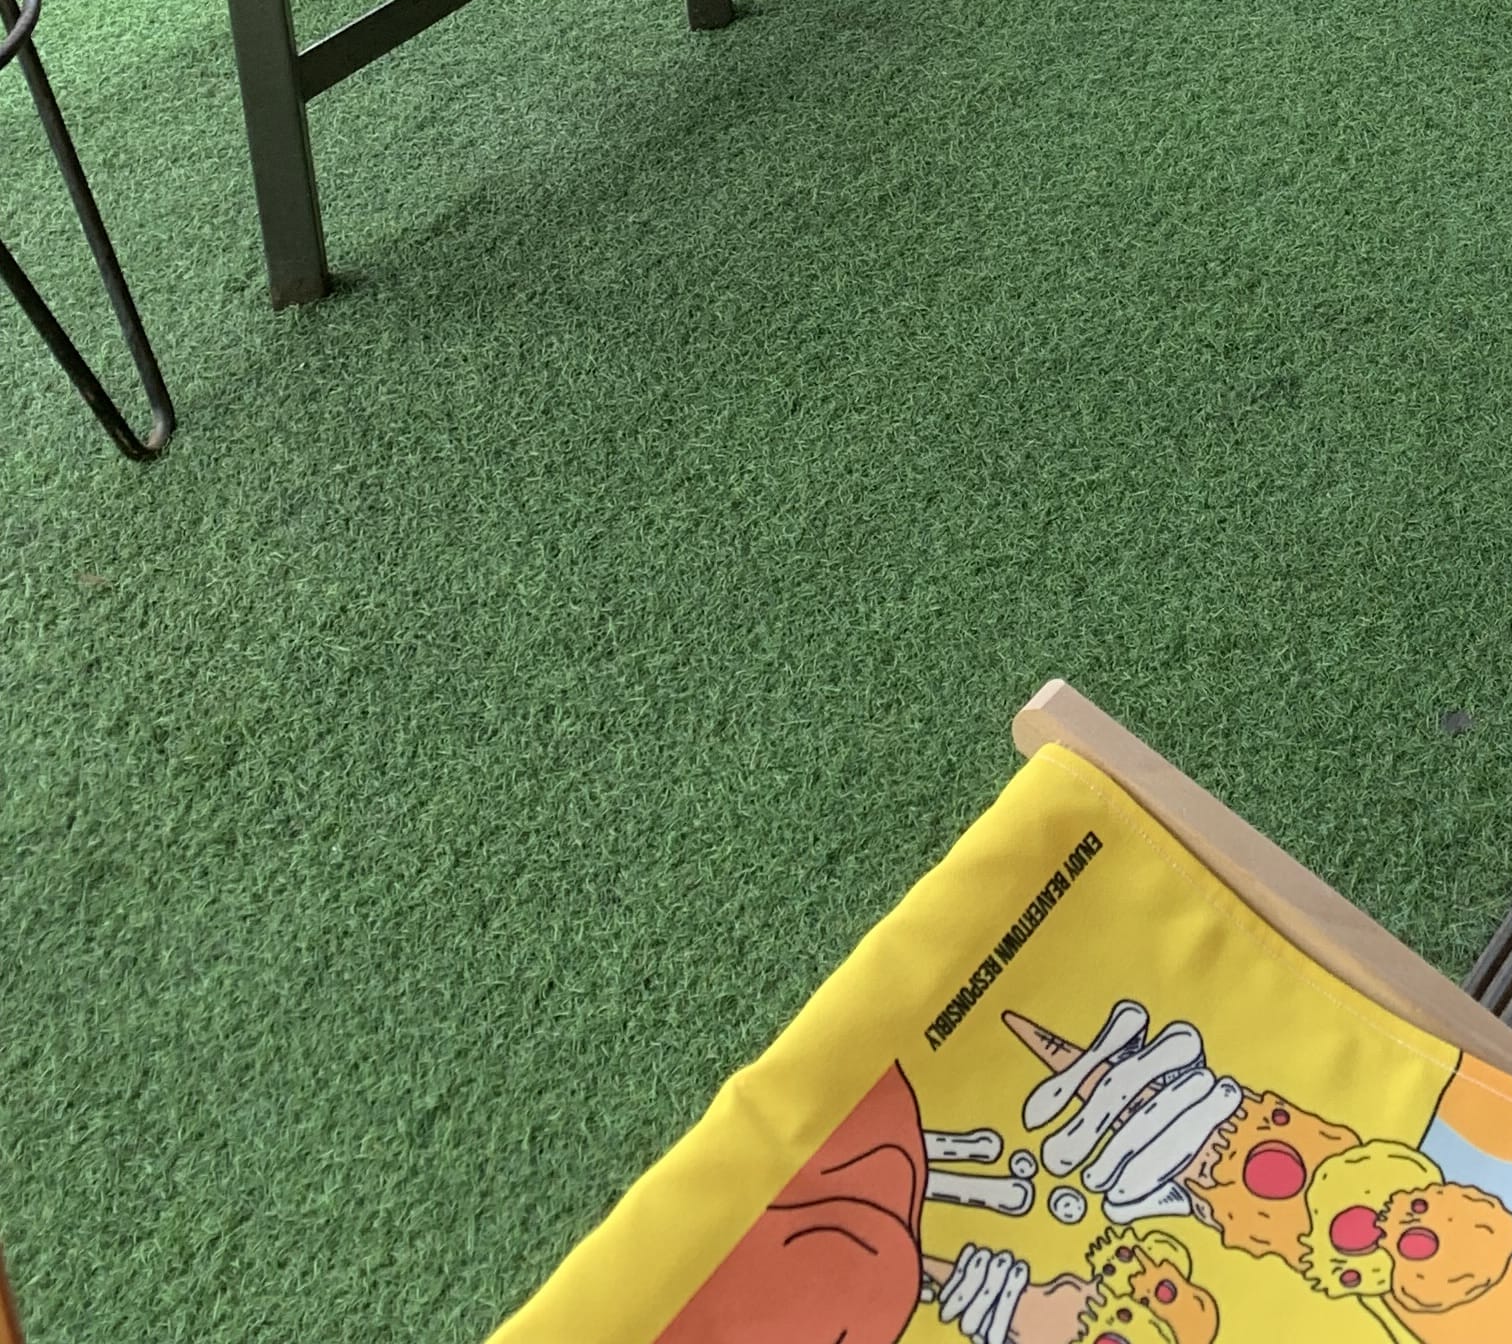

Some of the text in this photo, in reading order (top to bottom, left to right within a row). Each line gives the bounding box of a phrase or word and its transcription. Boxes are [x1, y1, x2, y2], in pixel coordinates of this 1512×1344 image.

[924, 831, 1103, 1052] ENJOY BEAVERTOWN RESPONSIBLY
